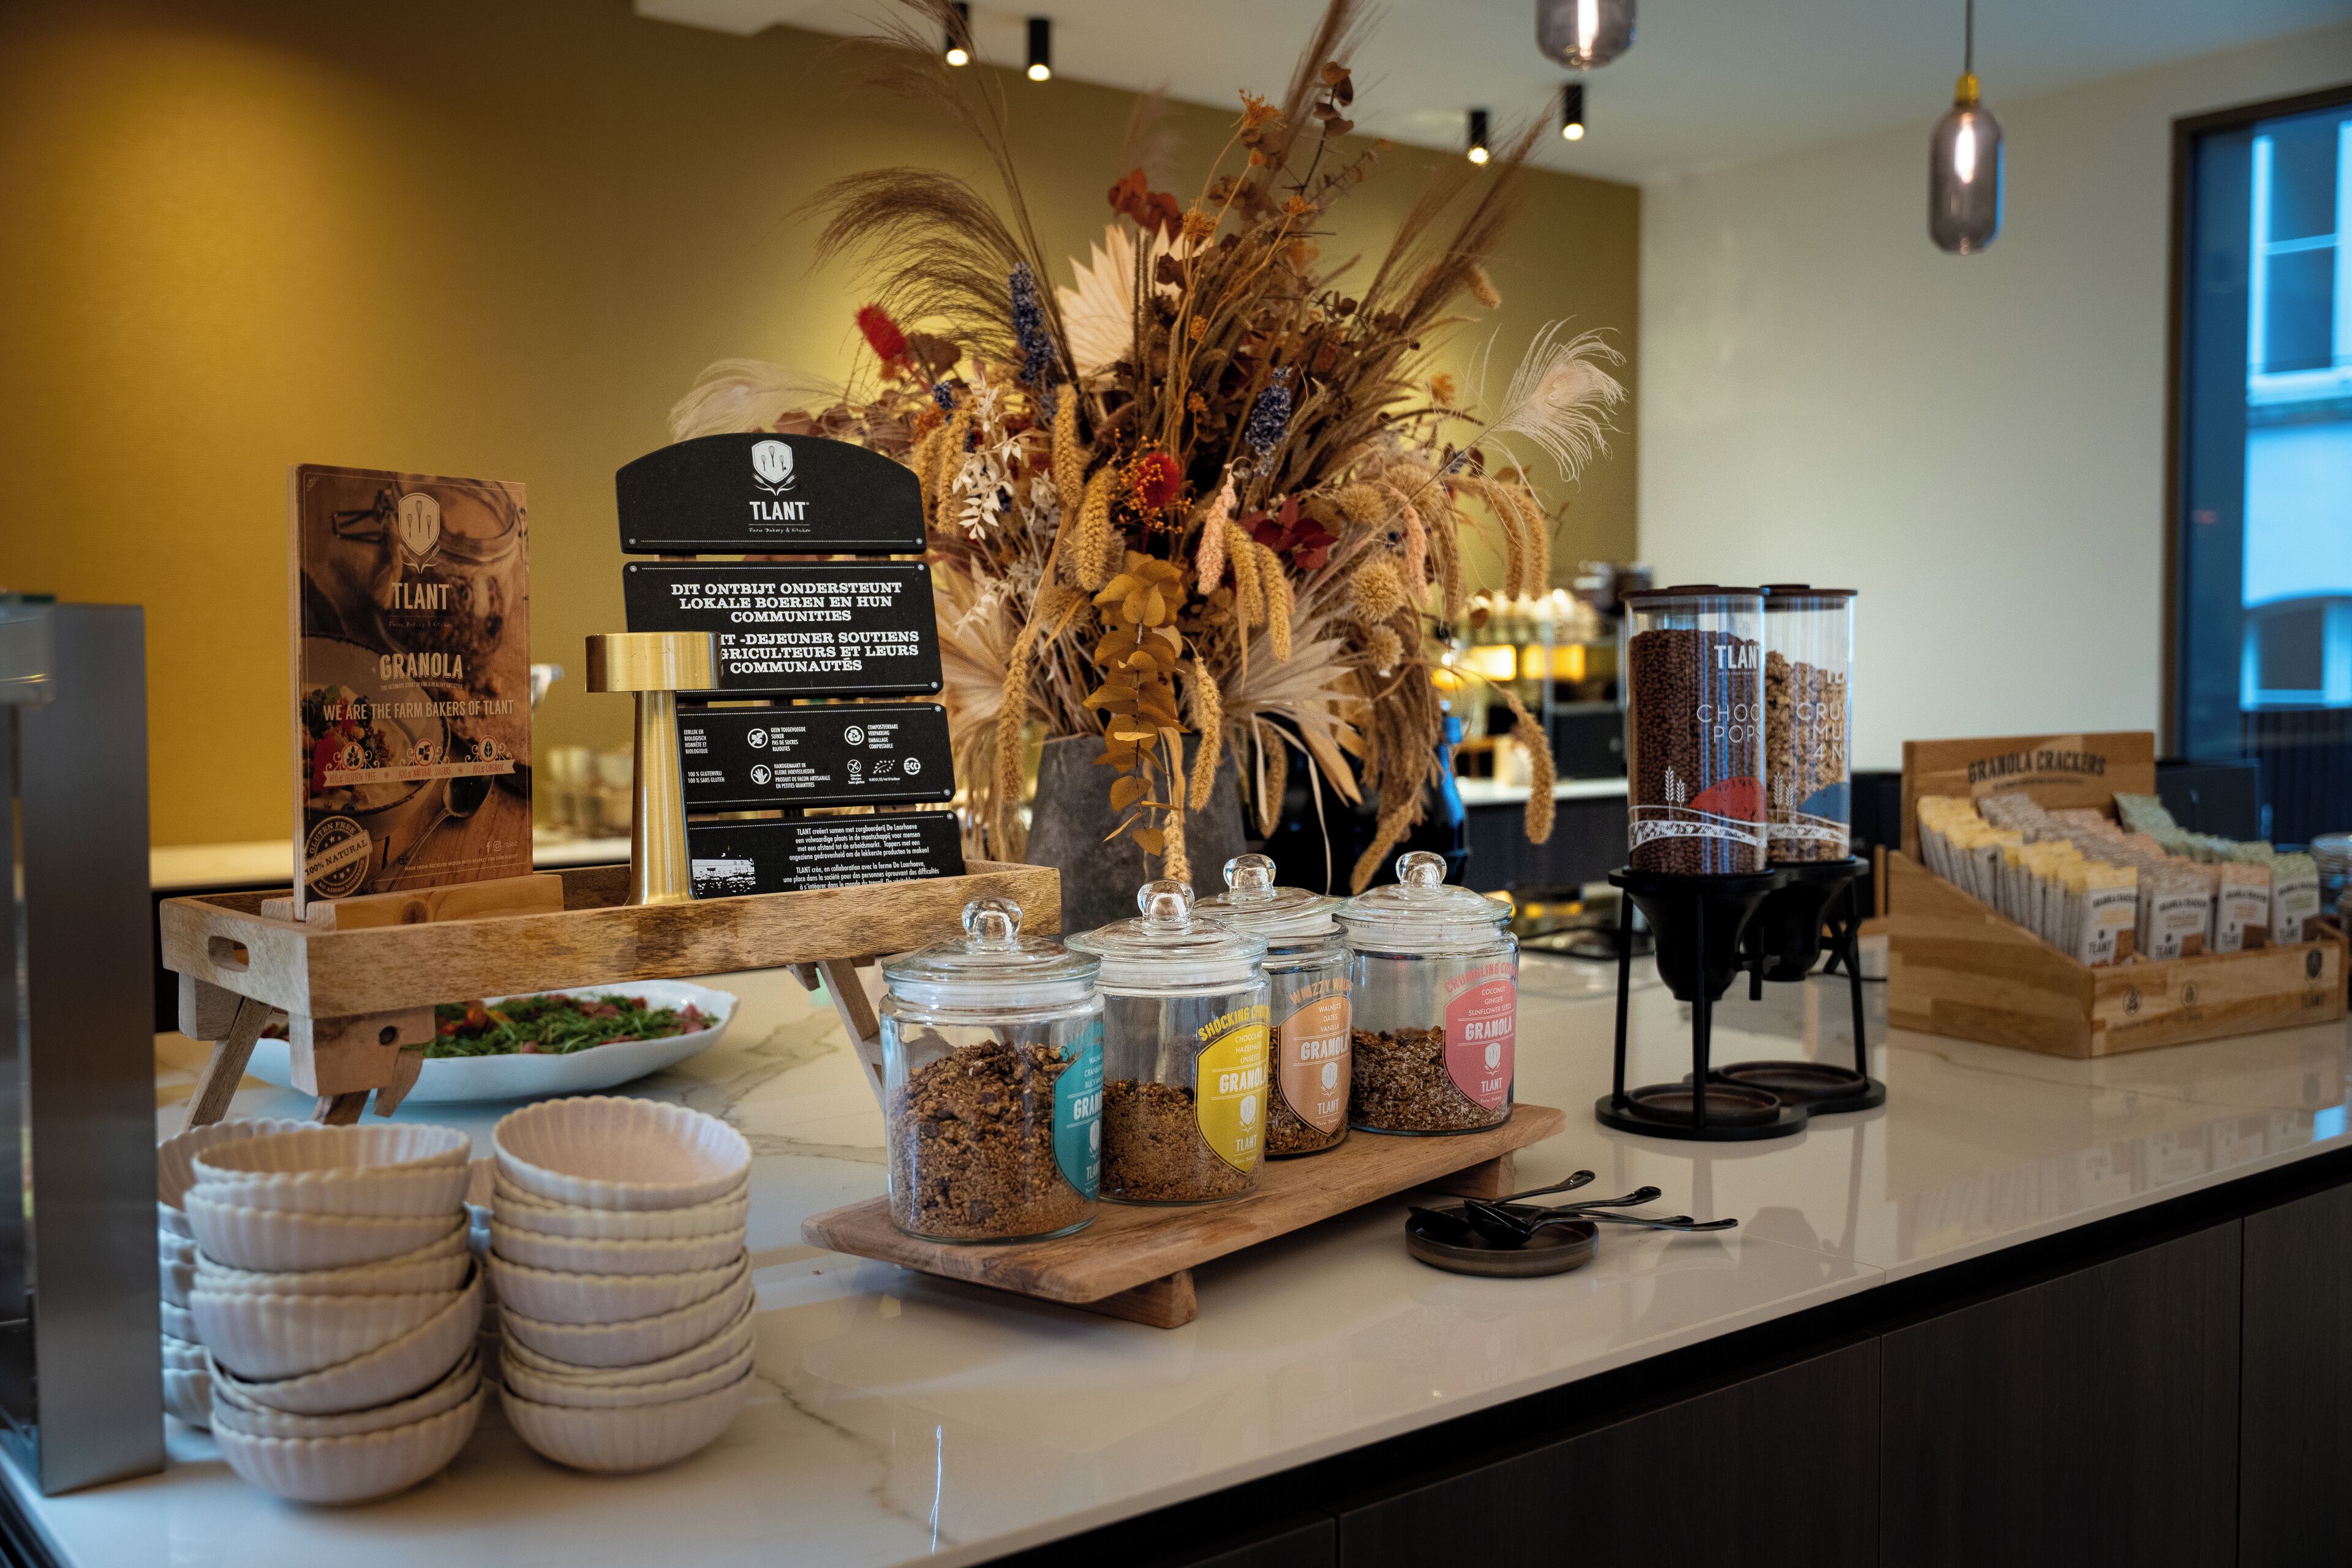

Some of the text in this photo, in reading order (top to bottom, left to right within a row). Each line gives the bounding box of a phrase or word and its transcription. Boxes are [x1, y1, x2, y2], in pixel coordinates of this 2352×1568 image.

[750, 502, 805, 520] TLANT
[392, 582, 450, 609] TLANT
[671, 583, 902, 595] DIT ONTBIJT ONDERSTEUNT
[680, 597, 892, 609] LOKALE BOEREN EN HUN
[730, 611, 851, 623] COMMUNITIES
[839, 631, 919, 643] SOUTIENS
[722, 645, 918, 660] GRICULTEURS ET LEURS
[380, 653, 463, 680] GRANOLA
[730, 658, 862, 674] COMMUNAUTÉS
[323, 699, 514, 721] WE ARE THE FARM BAKERS OF TLANT
[413, 767, 451, 777] NATURAL SUGARS
[486, 763, 504, 774] ORGANIC
[1968, 750, 2031, 784] GRANOLA
[2036, 750, 2105, 775] CRACKERS
[345, 773, 363, 782] GLUTEN
[856, 824, 885, 833] zorgboerderij
[310, 821, 355, 853] GLUTEN FREE
[306, 840, 367, 876] 100% NATURAL
[814, 851, 845, 861] gedrevenheid
[883, 848, 905, 856] producten
[1444, 962, 1499, 995] CRUMBLING
[1289, 979, 1330, 1005] WHIZZY
[1482, 986, 1506, 995] COCONUT
[1319, 1003, 1341, 1012] WALNUTS
[1469, 1006, 1500, 1016] SUNFLOWER
[1198, 1007, 1249, 1041] SHOCKING
[1465, 1016, 1512, 1041] GRANOLA
[1235, 1031, 1263, 1042] CHOCOLATE
[1236, 1042, 1262, 1054] HAZELNUTS
[1301, 1034, 1348, 1060] GRANOLA
[1241, 1054, 1259, 1063] LINSEED
[1219, 1065, 1267, 1094] GRANOLA
[1481, 1077, 1502, 1092] TLANT
[1317, 1099, 1340, 1114] TLANT
[1236, 1134, 1257, 1152] TLANT
